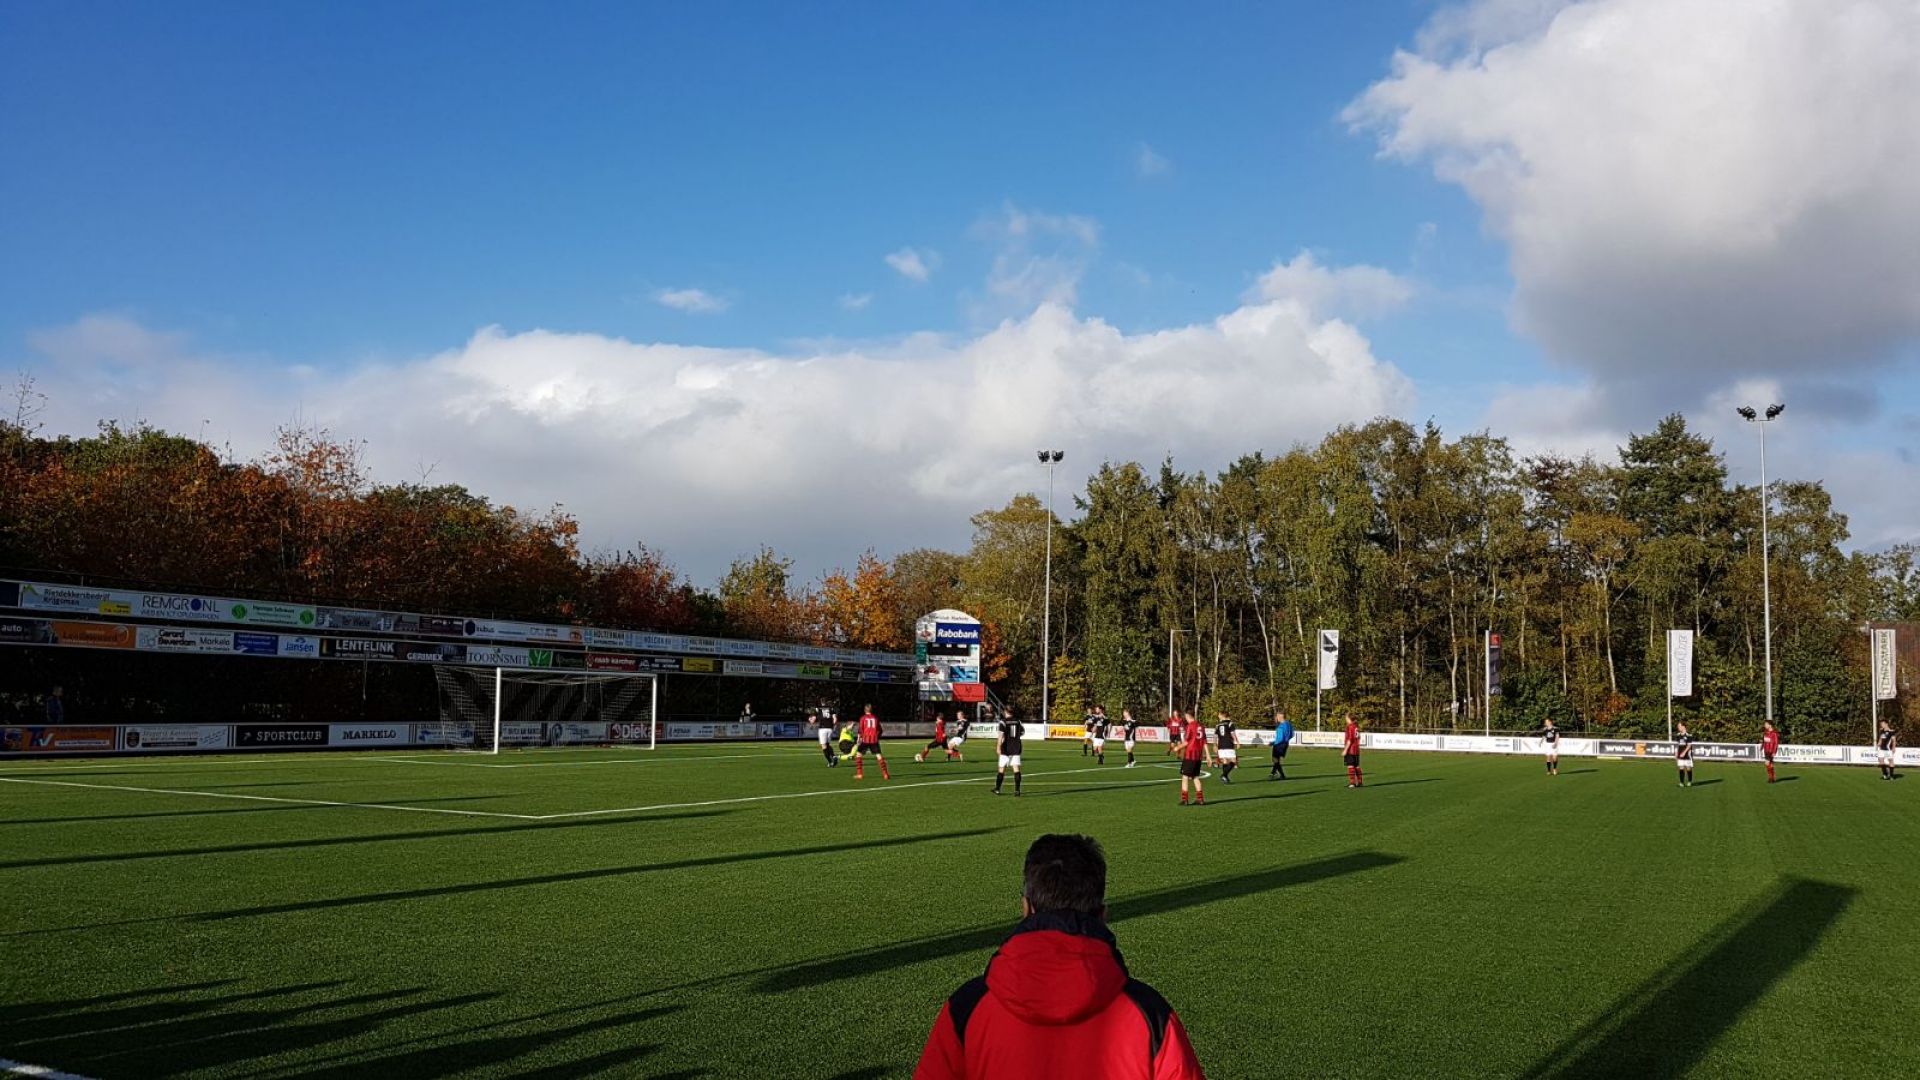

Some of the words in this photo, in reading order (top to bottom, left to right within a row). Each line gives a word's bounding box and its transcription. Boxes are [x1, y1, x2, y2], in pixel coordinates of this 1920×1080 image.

[1, 623, 23, 632] auto
[159, 629, 185, 638] Gerard
[937, 628, 979, 639] Rabobank
[200, 637, 230, 646] Markelo
[335, 639, 395, 653] LENTELINK
[285, 641, 314, 653] Jansen
[865, 718, 876, 728] 11
[256, 730, 323, 741] SPORTCLUB
[342, 730, 397, 740] MARKELO
